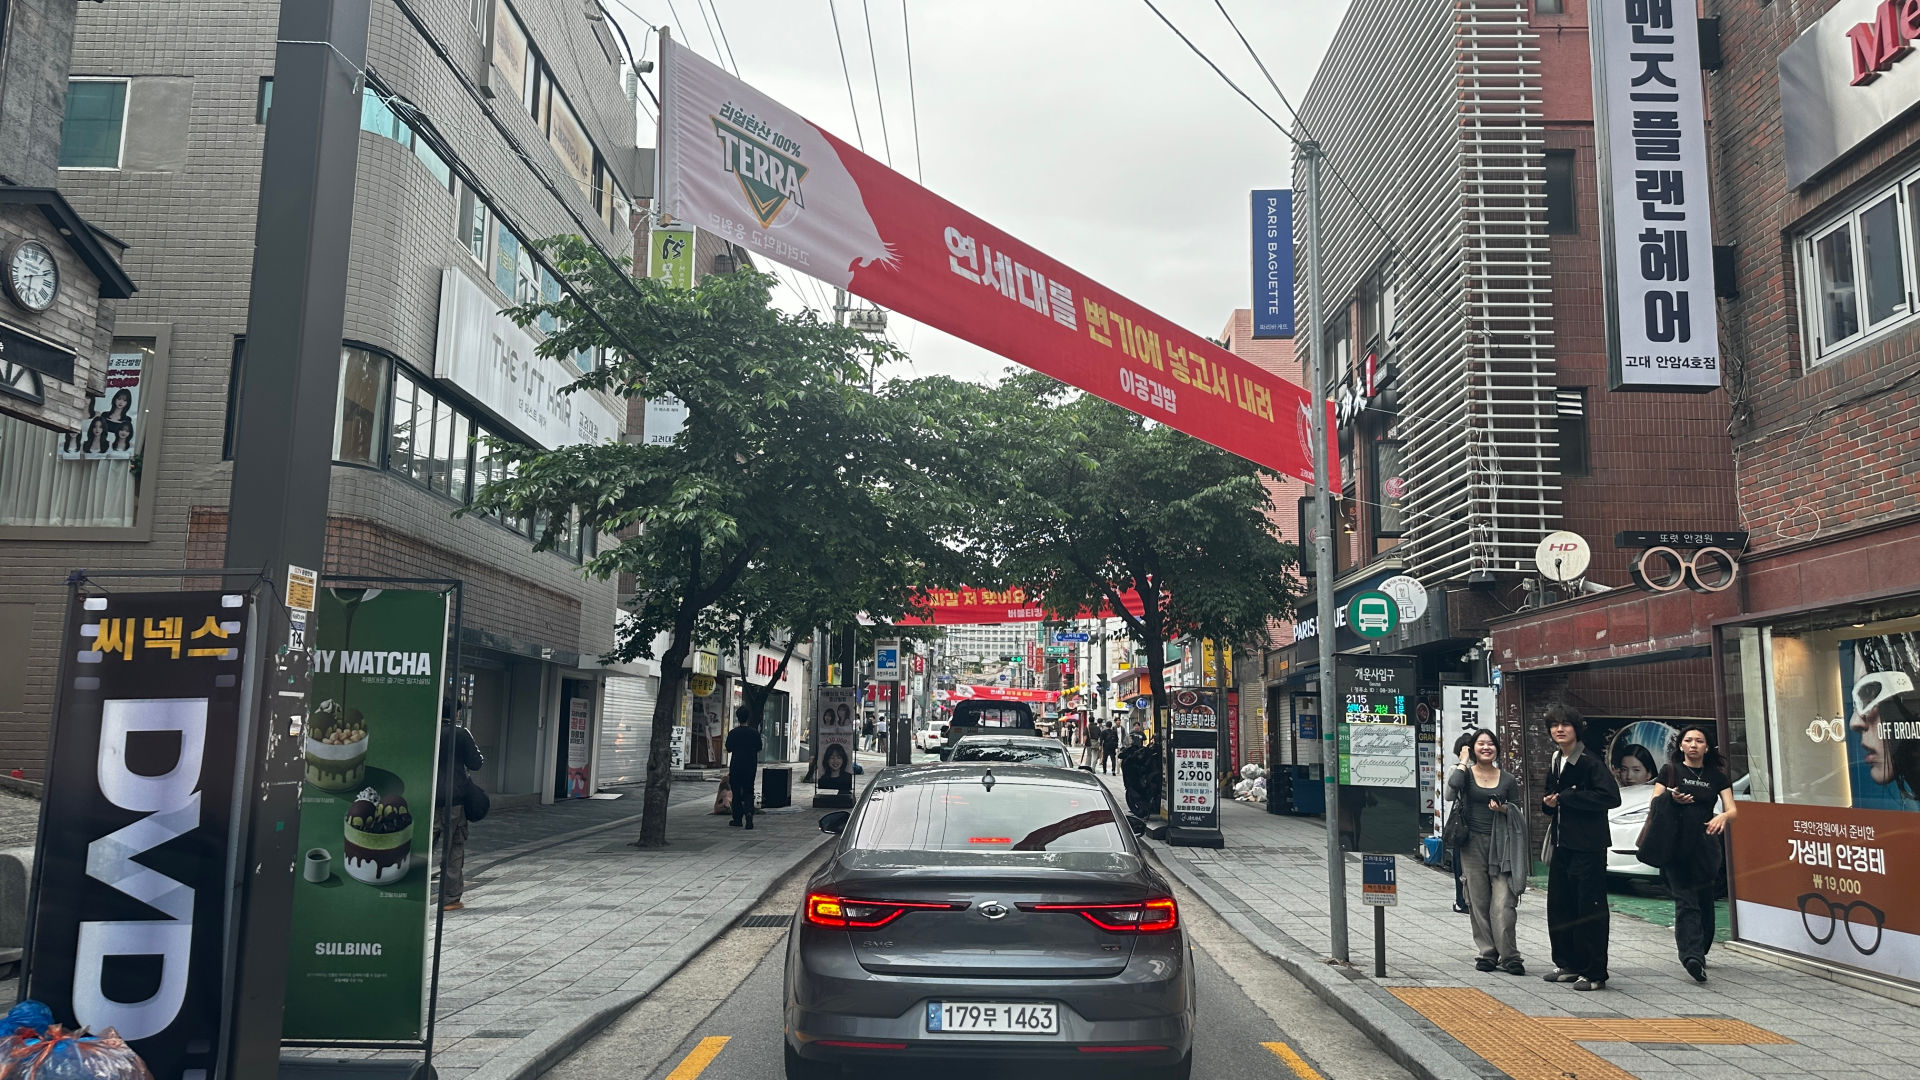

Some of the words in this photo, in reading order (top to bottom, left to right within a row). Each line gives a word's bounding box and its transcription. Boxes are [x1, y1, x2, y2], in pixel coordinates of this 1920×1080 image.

[719, 101, 772, 142] 리얼탄산
[772, 131, 801, 159] 100%
[716, 128, 805, 209] TERRA
[1625, 0, 1691, 343] 맨즈플랜헤어
[1267, 198, 1277, 238] PARIS
[1268, 242, 1278, 315] BAGUETTE
[944, 226, 1078, 332] 연세대를
[1083, 297, 1164, 372] 변기에
[1167, 338, 1232, 403] 넣고서
[1234, 373, 1274, 423] 내려
[1625, 356, 1650, 368] 고대
[1656, 356, 1716, 369] 안암4호점
[493, 333, 519, 383] THE
[522, 360, 545, 403] 1ST
[547, 381, 572, 428] HAIR
[1120, 367, 1177, 414] 이공김밥
[1550, 543, 1578, 552] HD
[1660, 534, 1679, 544] 또렷
[1683, 534, 1713, 544] 안경원
[91, 615, 232, 661] 씨넥스
[292, 632, 302, 647] 14
[340, 651, 431, 675] MATCHA
[1355, 668, 1395, 681] 개운사입구
[1346, 695, 1367, 703] 2115
[1878, 722, 1892, 740] OFF
[1178, 770, 1212, 781] 2,900
[1793, 820, 1847, 838] 또렷안경원에서
[1849, 825, 1875, 840] 준비한
[1787, 839, 1832, 868] 가성비
[1835, 844, 1886, 875] 안경테
[1384, 869, 1394, 881] 11
[1823, 875, 1861, 895] 19,000
[315, 942, 382, 955] SULBING
[945, 1006, 997, 1027] 179무
[1004, 1006, 1052, 1029] 1463
